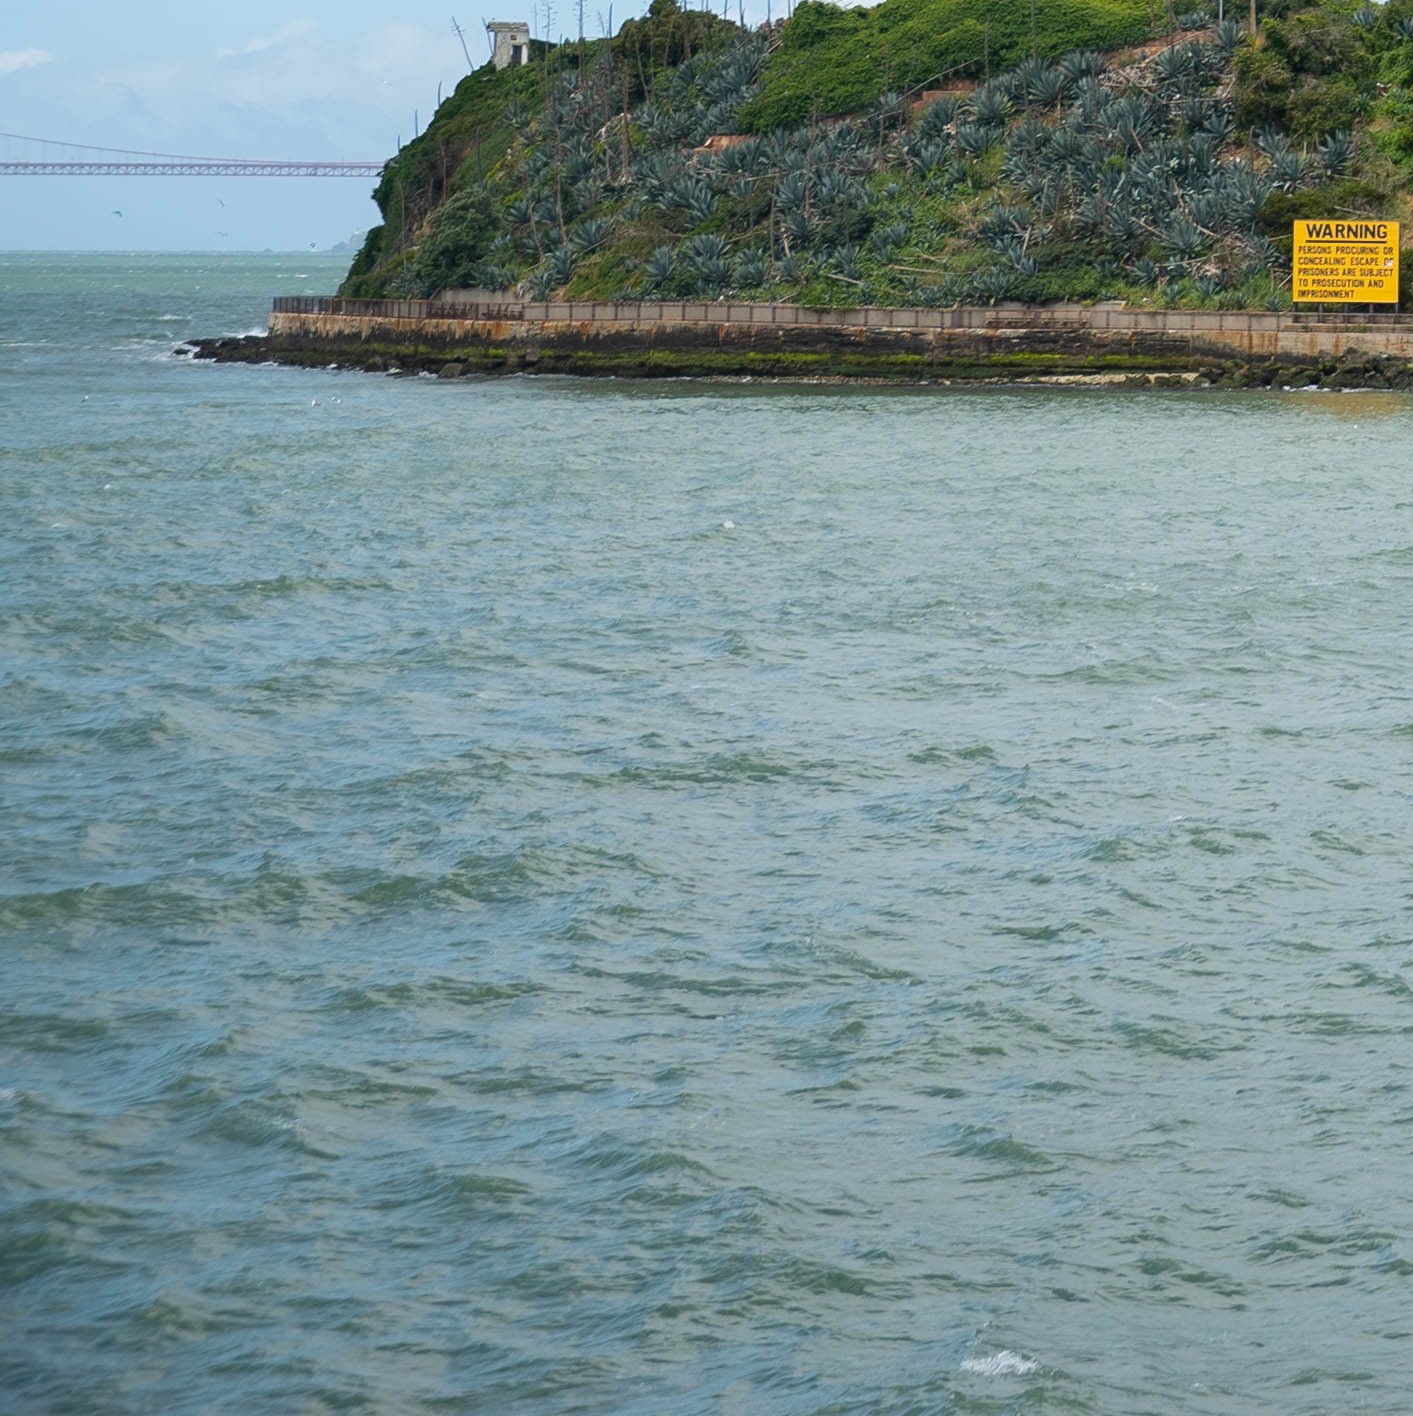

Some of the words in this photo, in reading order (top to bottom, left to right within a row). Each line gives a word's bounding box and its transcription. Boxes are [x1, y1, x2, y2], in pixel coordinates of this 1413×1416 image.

[1306, 224, 1387, 239] WARNING
[1298, 246, 1331, 254] PERSONS
[1336, 246, 1379, 255] PROCURING
[1383, 246, 1394, 255] OR
[1298, 257, 1345, 265] CONCEALING
[1350, 257, 1379, 266] ESCAPE
[1298, 268, 1339, 276] PRISONERS
[1342, 268, 1357, 276] ARE
[1360, 268, 1393, 277] SUBJECT
[1298, 279, 1308, 287] TO
[1311, 279, 1364, 287] PROSECUTION
[1368, 279, 1384, 288] AND
[1298, 290, 1354, 298] IMPRISONMENT
